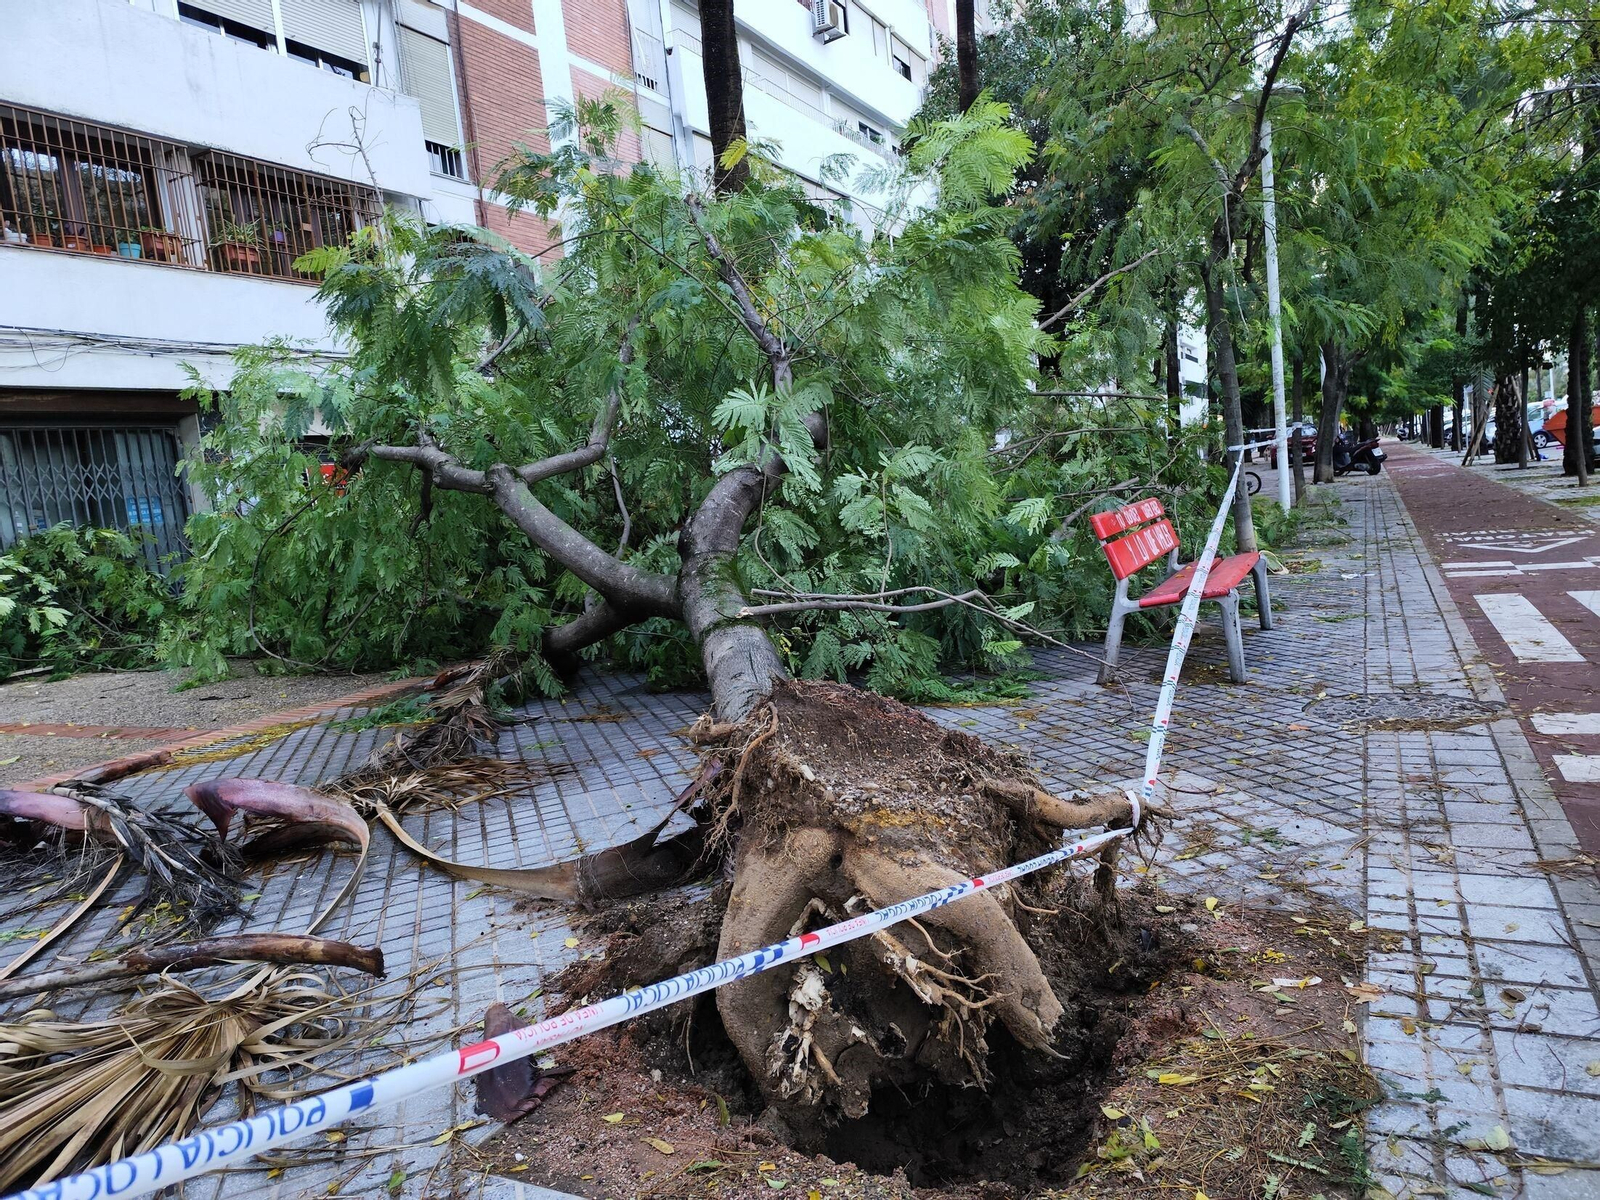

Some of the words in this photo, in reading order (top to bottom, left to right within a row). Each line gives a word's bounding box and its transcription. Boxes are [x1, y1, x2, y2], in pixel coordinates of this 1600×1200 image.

[684, 957, 745, 992] POLICIA
[616, 980, 680, 1014] LOCAL
[561, 1014, 574, 1027] DE
[174, 1096, 327, 1170] POLICIA
[0, 1149, 163, 1200] LOCA
